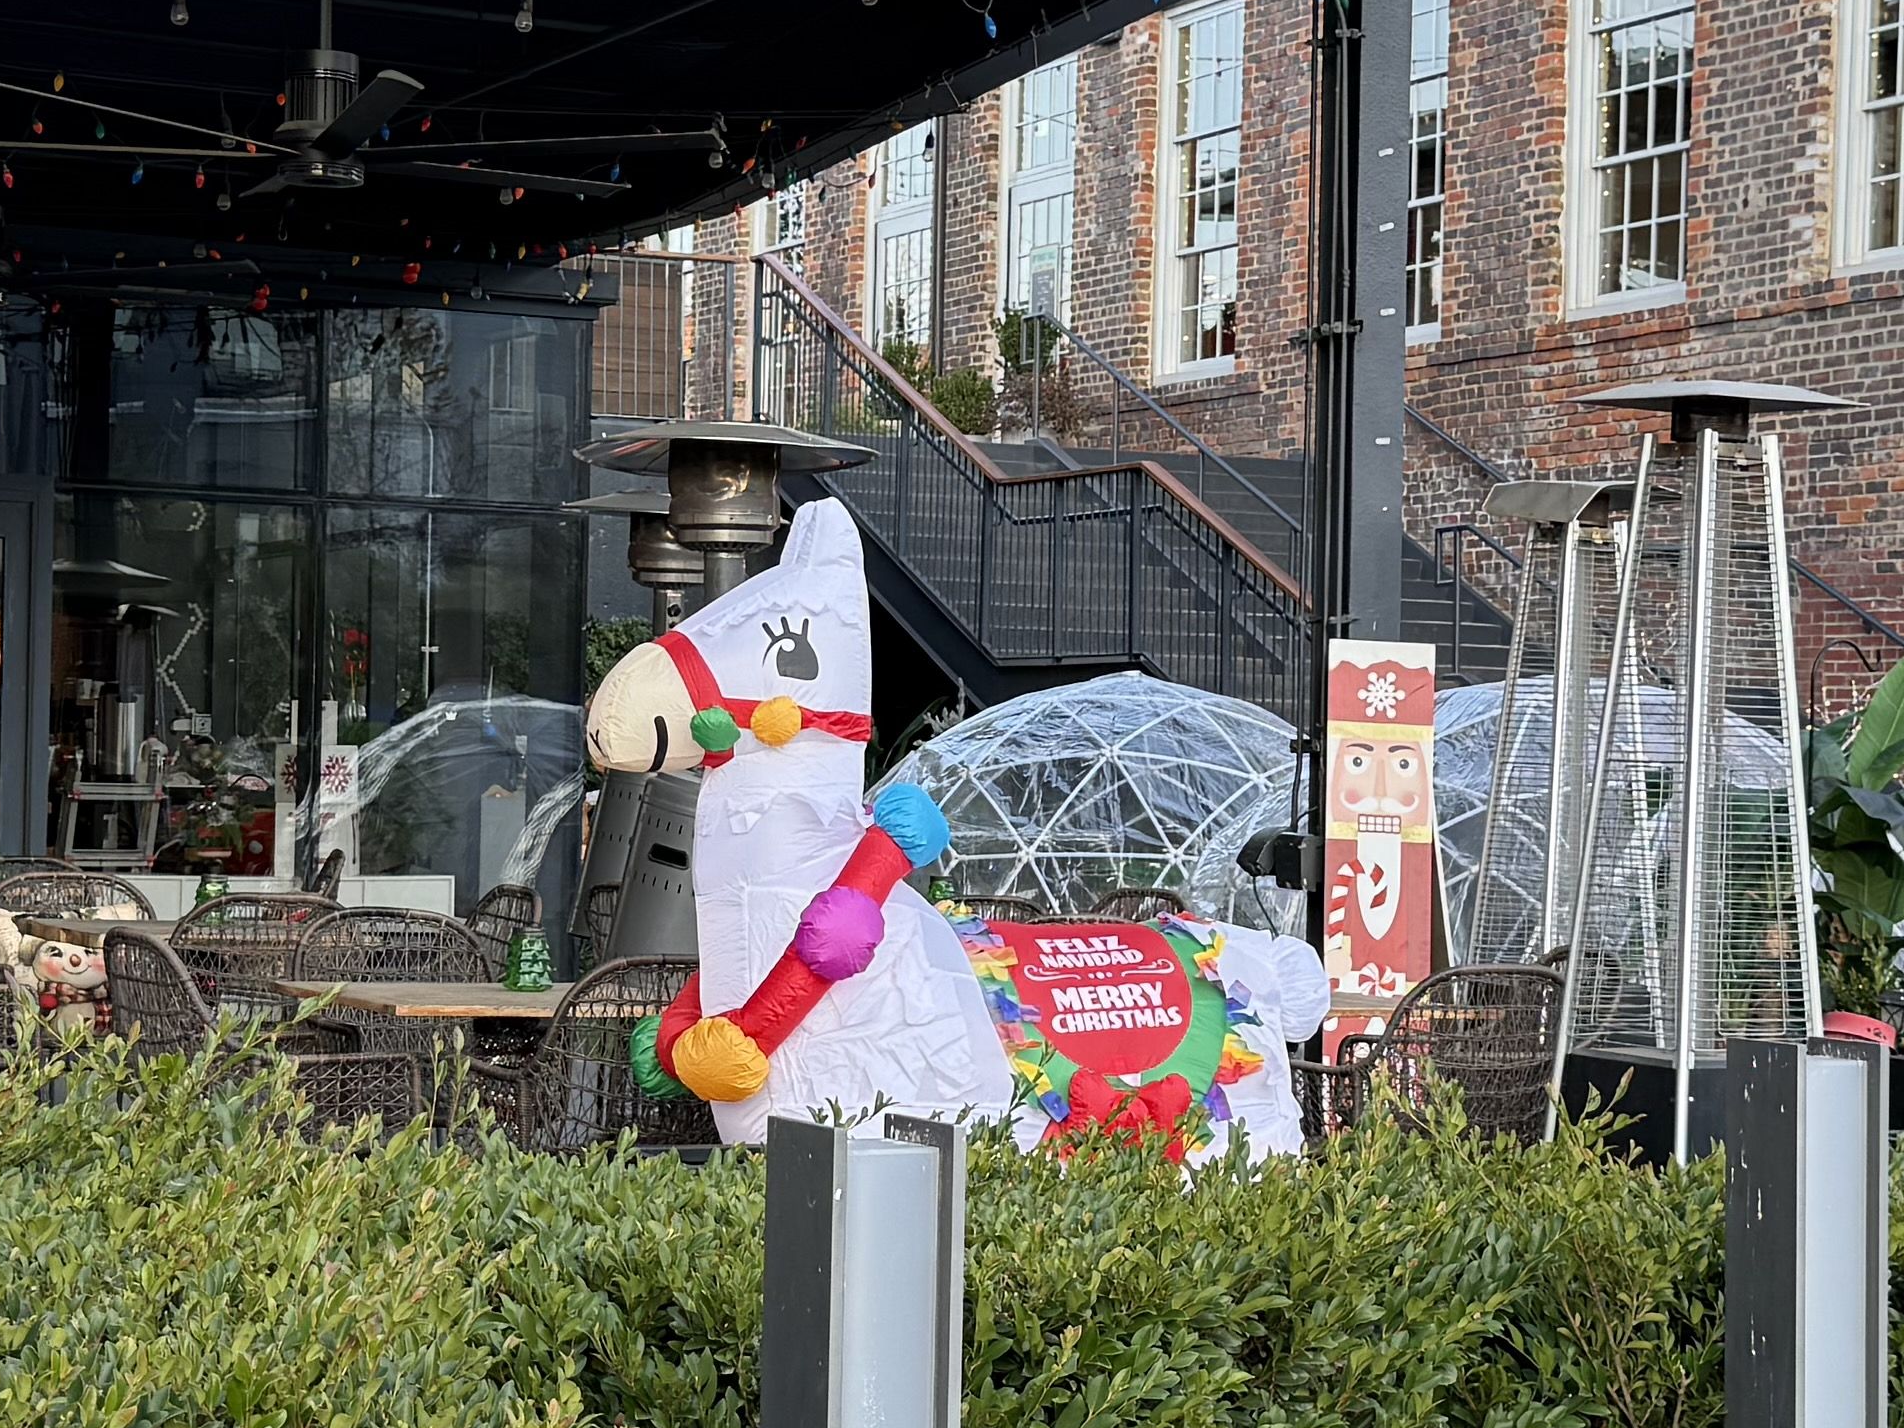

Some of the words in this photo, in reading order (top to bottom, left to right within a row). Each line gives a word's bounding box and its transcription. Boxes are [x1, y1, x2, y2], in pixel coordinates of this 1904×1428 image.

[1035, 935, 1128, 954] FELIZ
[1039, 949, 1144, 969] NAVIDAD
[1050, 981, 1163, 1012] MERRY
[1051, 1006, 1183, 1034] CHRISTMAS
